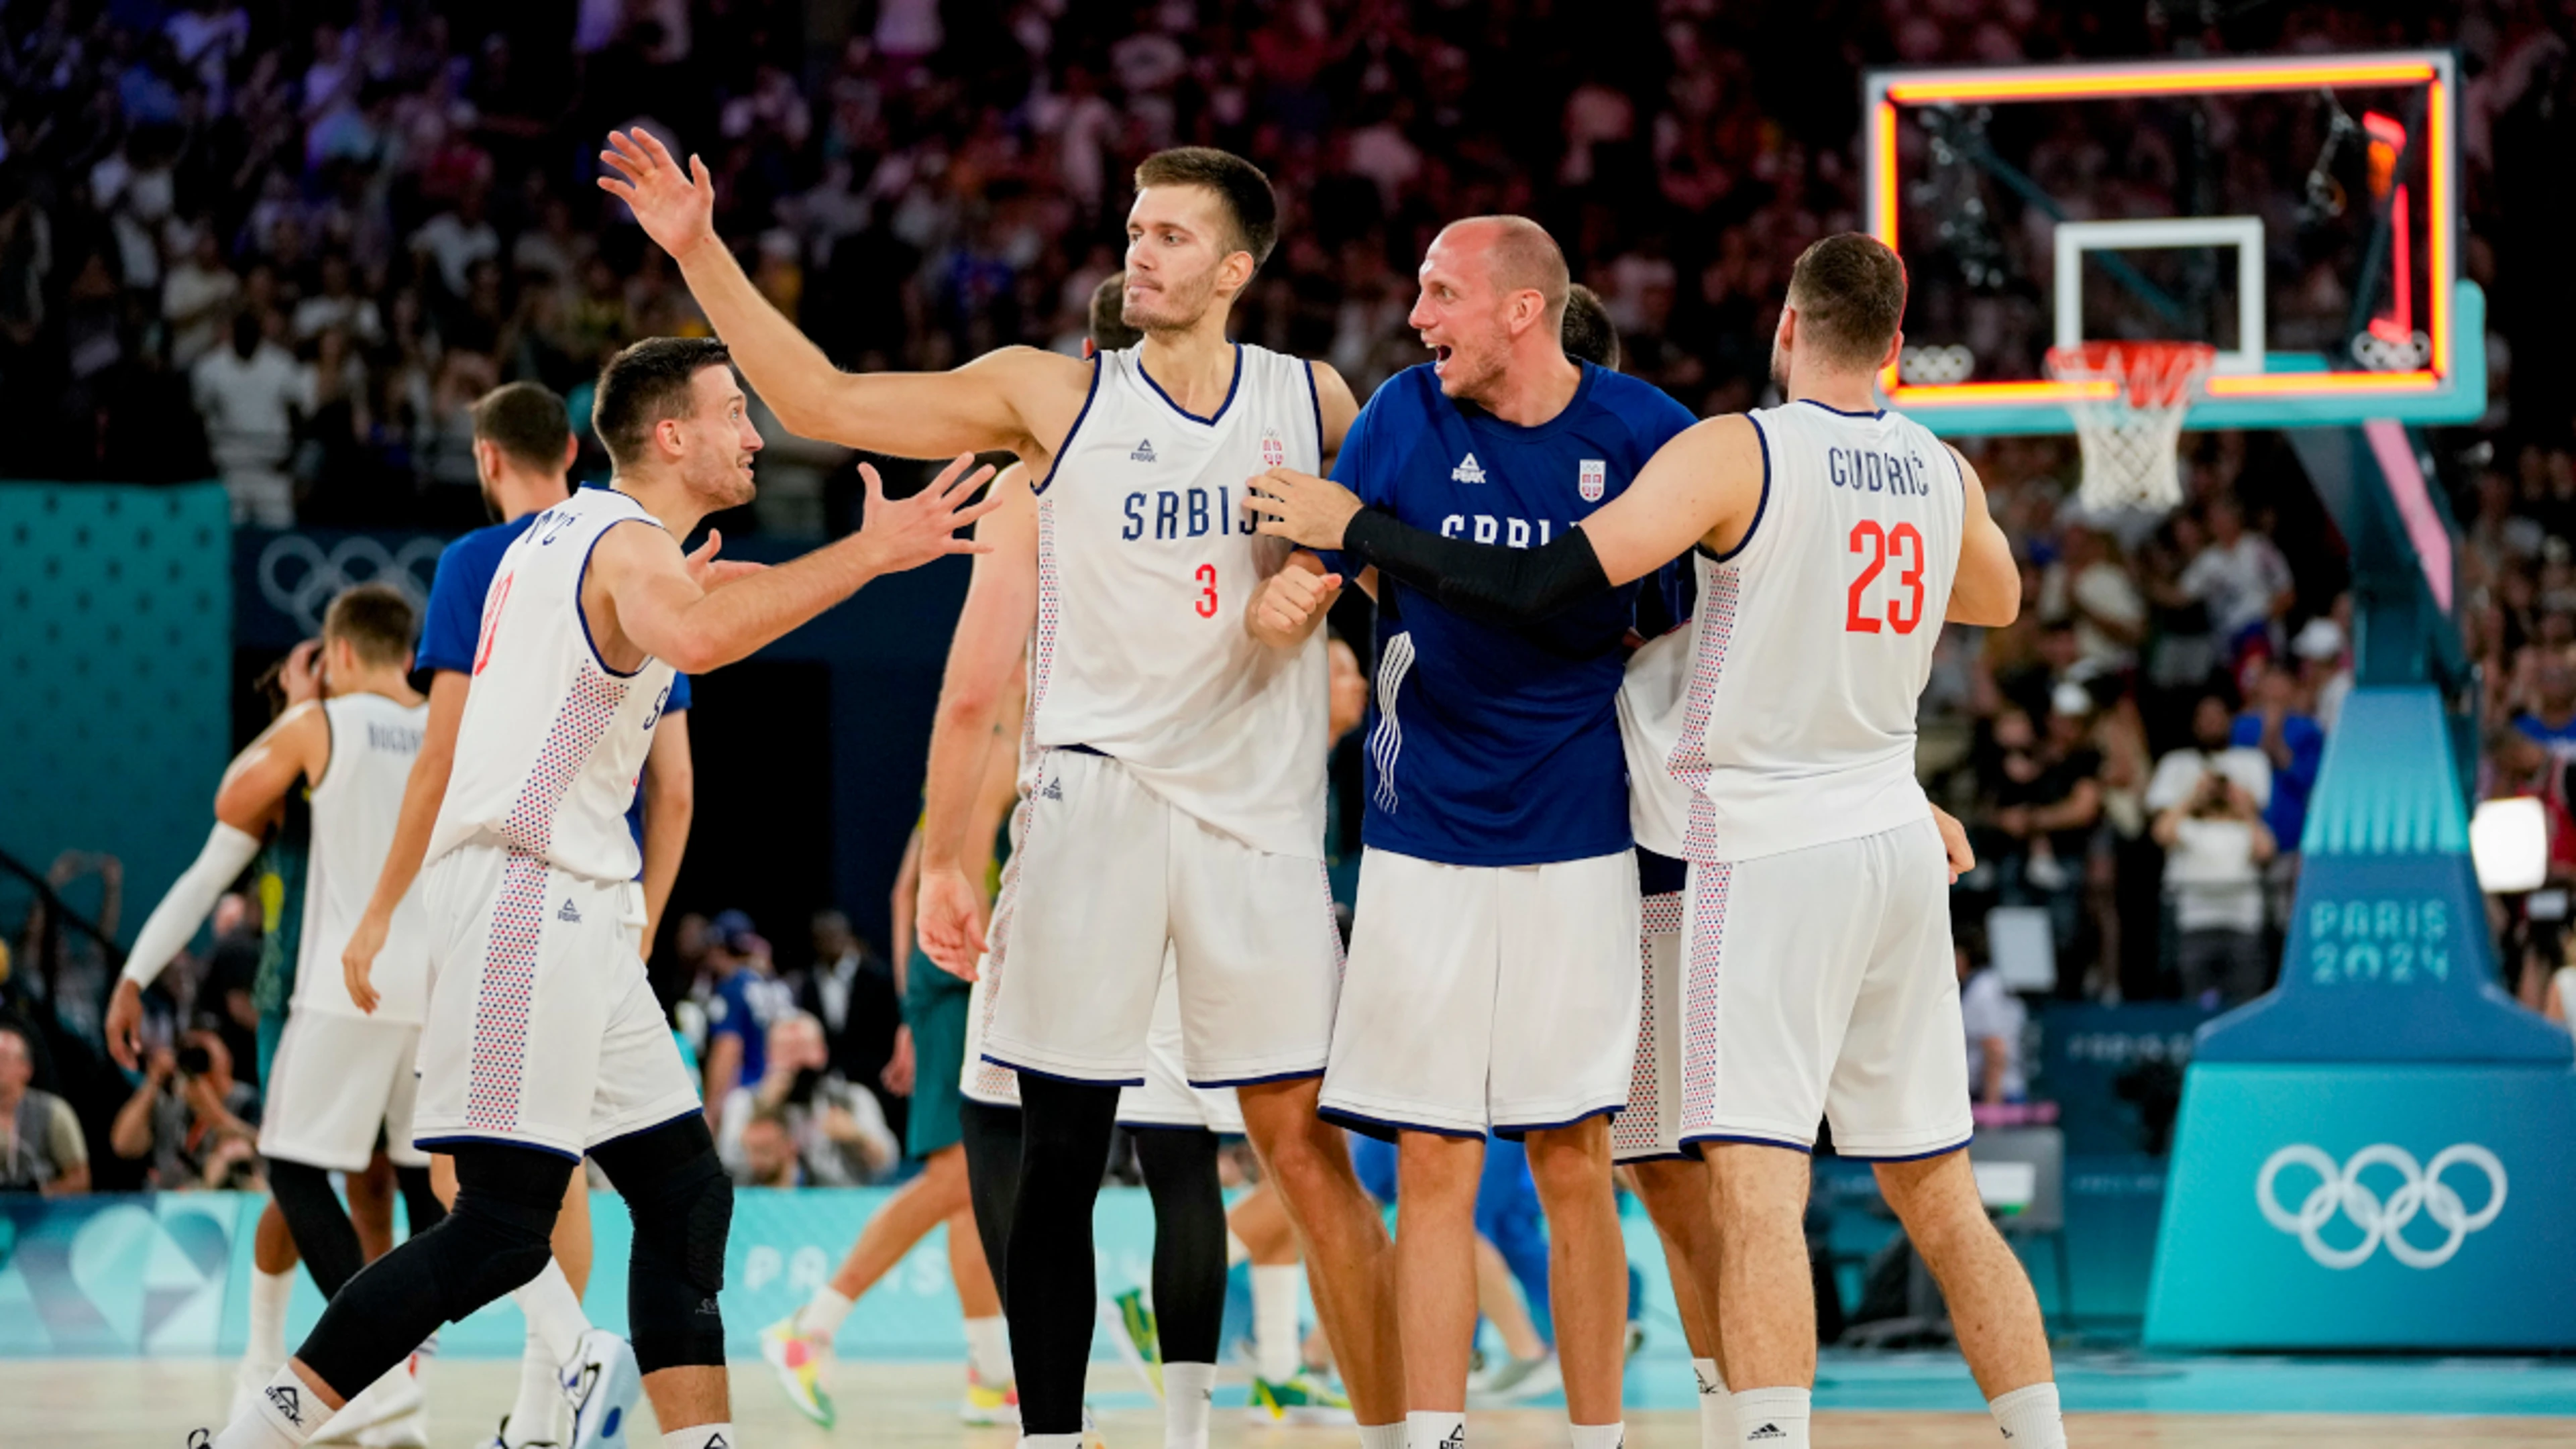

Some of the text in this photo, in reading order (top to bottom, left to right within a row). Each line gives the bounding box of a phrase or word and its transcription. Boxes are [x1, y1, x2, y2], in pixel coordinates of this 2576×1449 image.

[1451, 468, 1487, 484] PEAK
[1122, 485, 1286, 541] SRBIJ
[1195, 564, 1218, 619] 3
[1845, 519, 1925, 635] 23
[2310, 900, 2448, 941] PARIS
[2312, 942, 2449, 984] 2024
